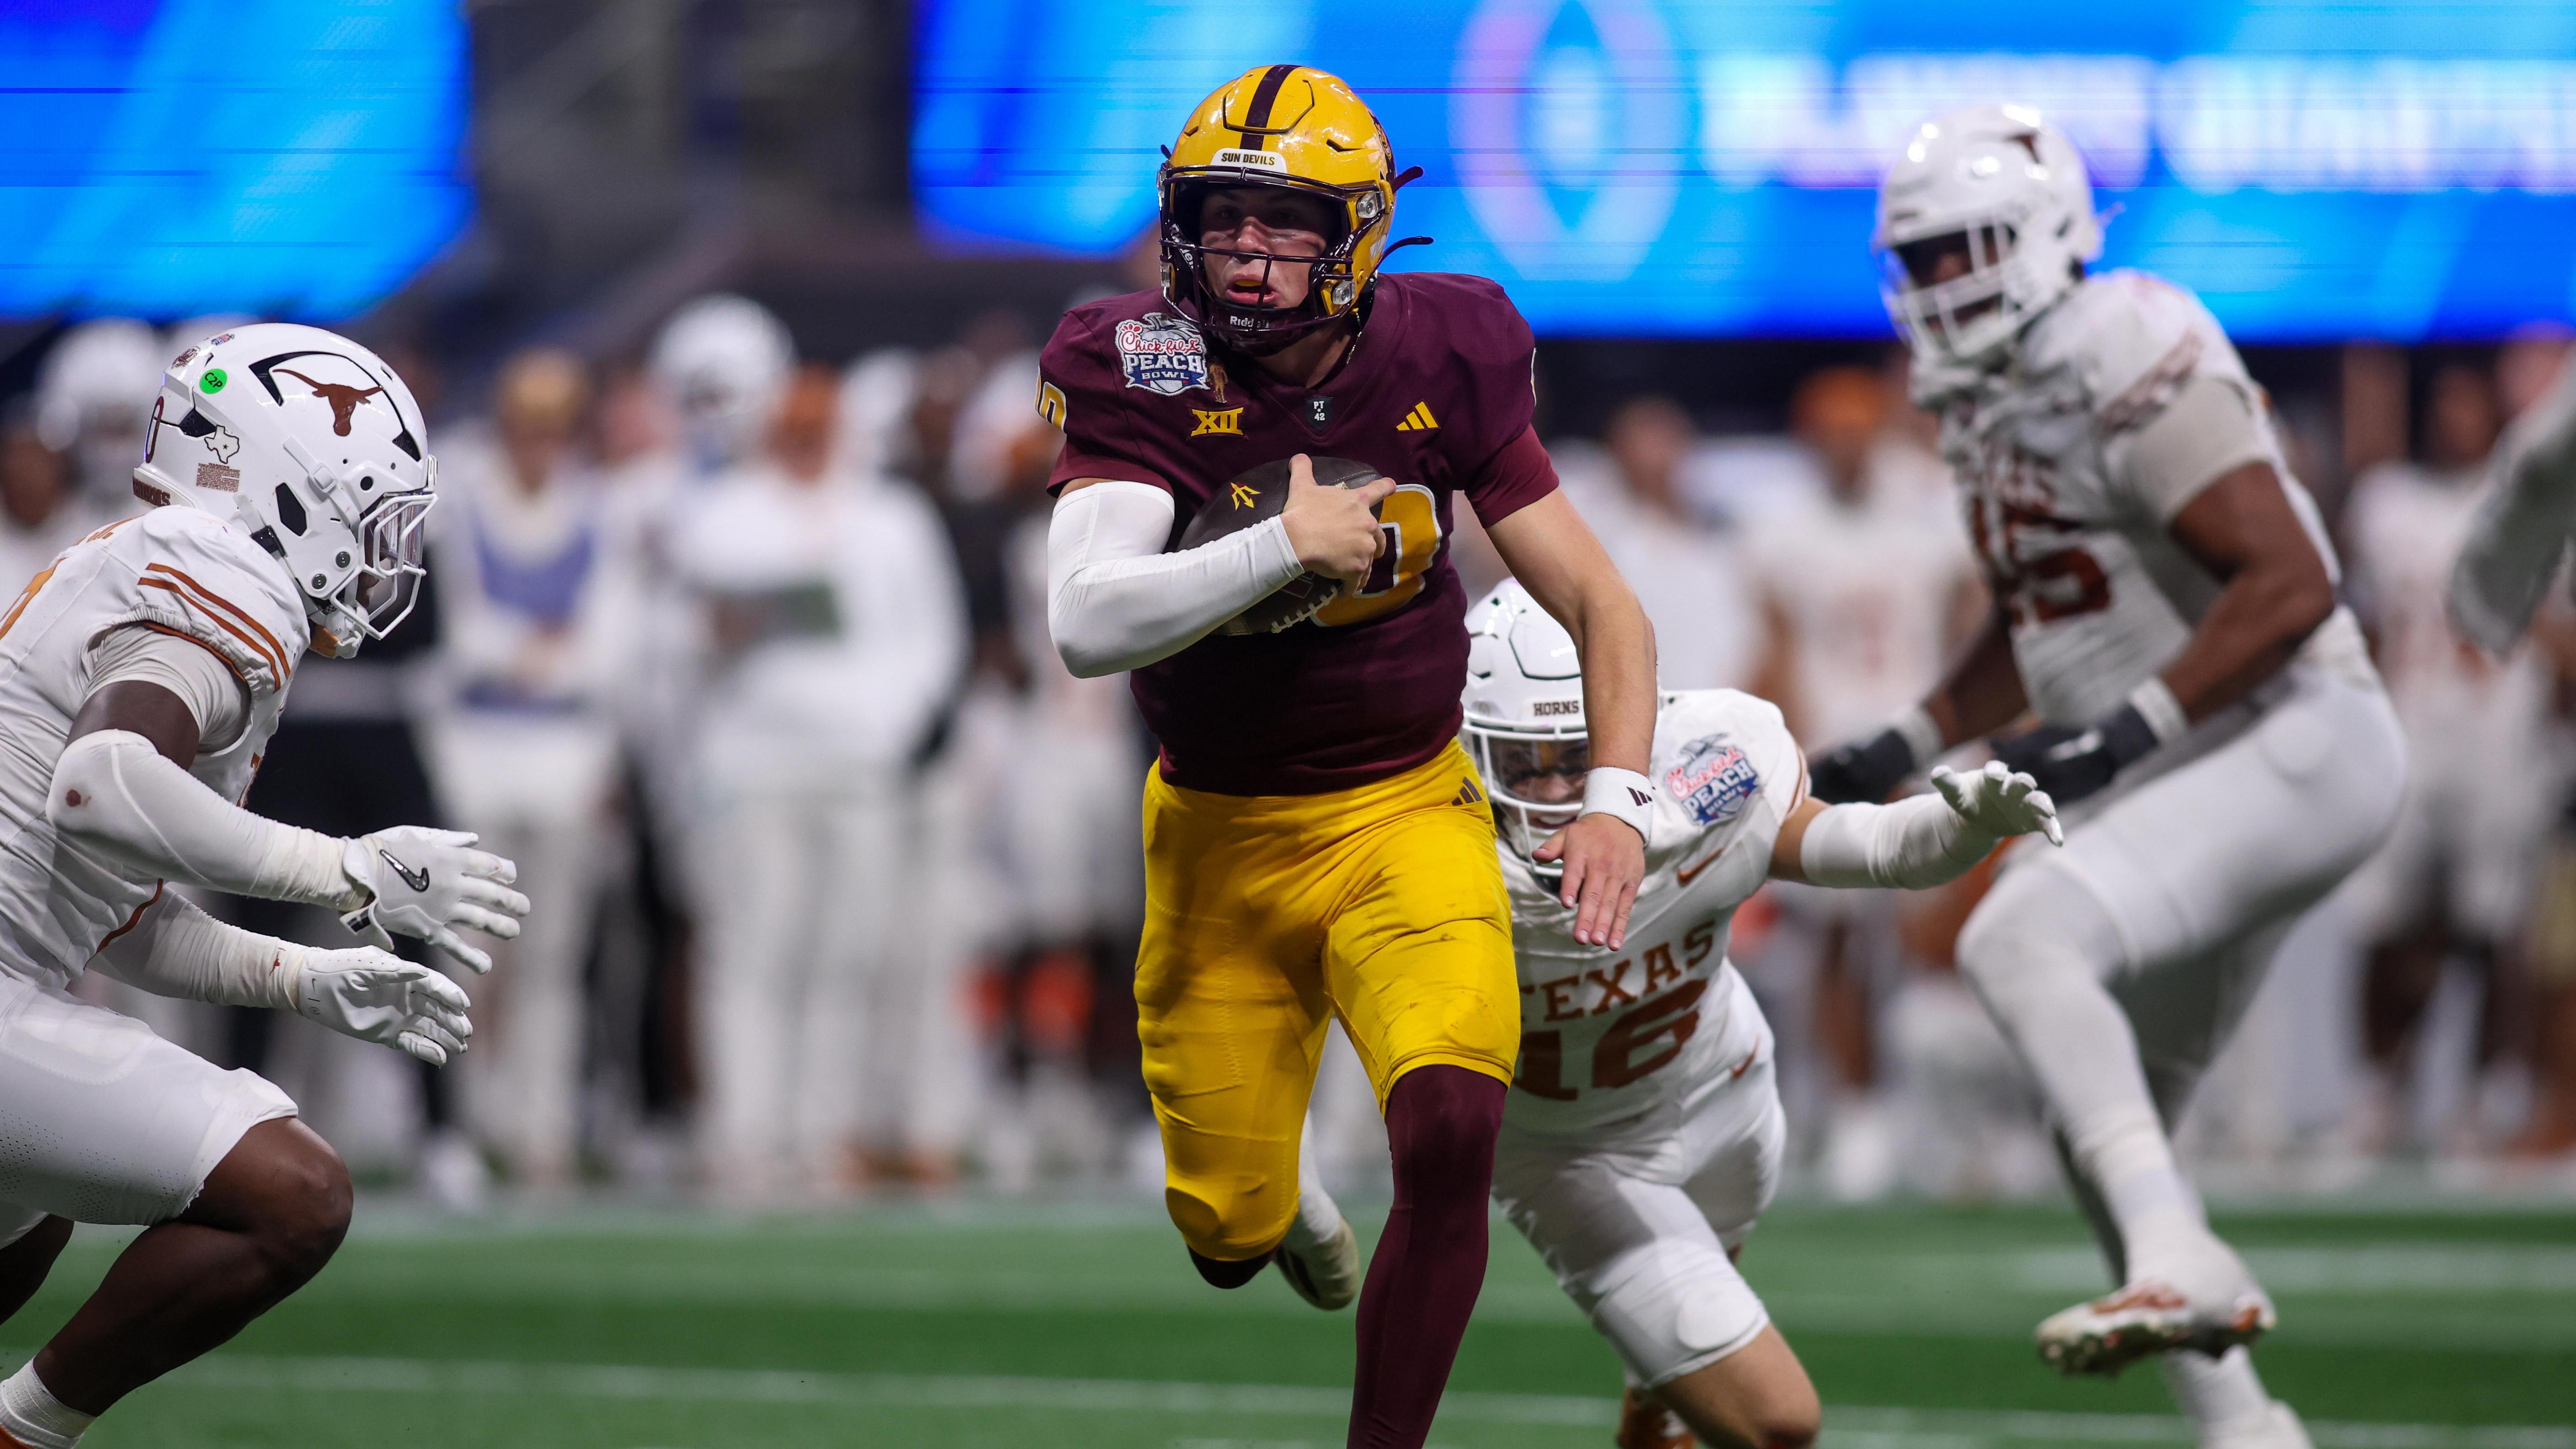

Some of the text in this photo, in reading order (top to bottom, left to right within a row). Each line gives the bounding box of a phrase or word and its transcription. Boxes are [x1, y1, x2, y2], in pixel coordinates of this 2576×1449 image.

[1221, 153, 1275, 165] SUN DEVILS
[1121, 324, 1201, 355] Chick-fil-A
[1125, 355, 1204, 374] PEACH
[204, 372, 223, 388] C2P
[1141, 371, 1189, 380] BOWL
[1314, 401, 1325, 409] PT
[1191, 407, 1244, 436] XII
[1314, 413, 1325, 421] 42
[1533, 701, 1579, 716] HORNS
[1682, 759, 1756, 821] PEACH
[1512, 979, 1707, 1100] 16
